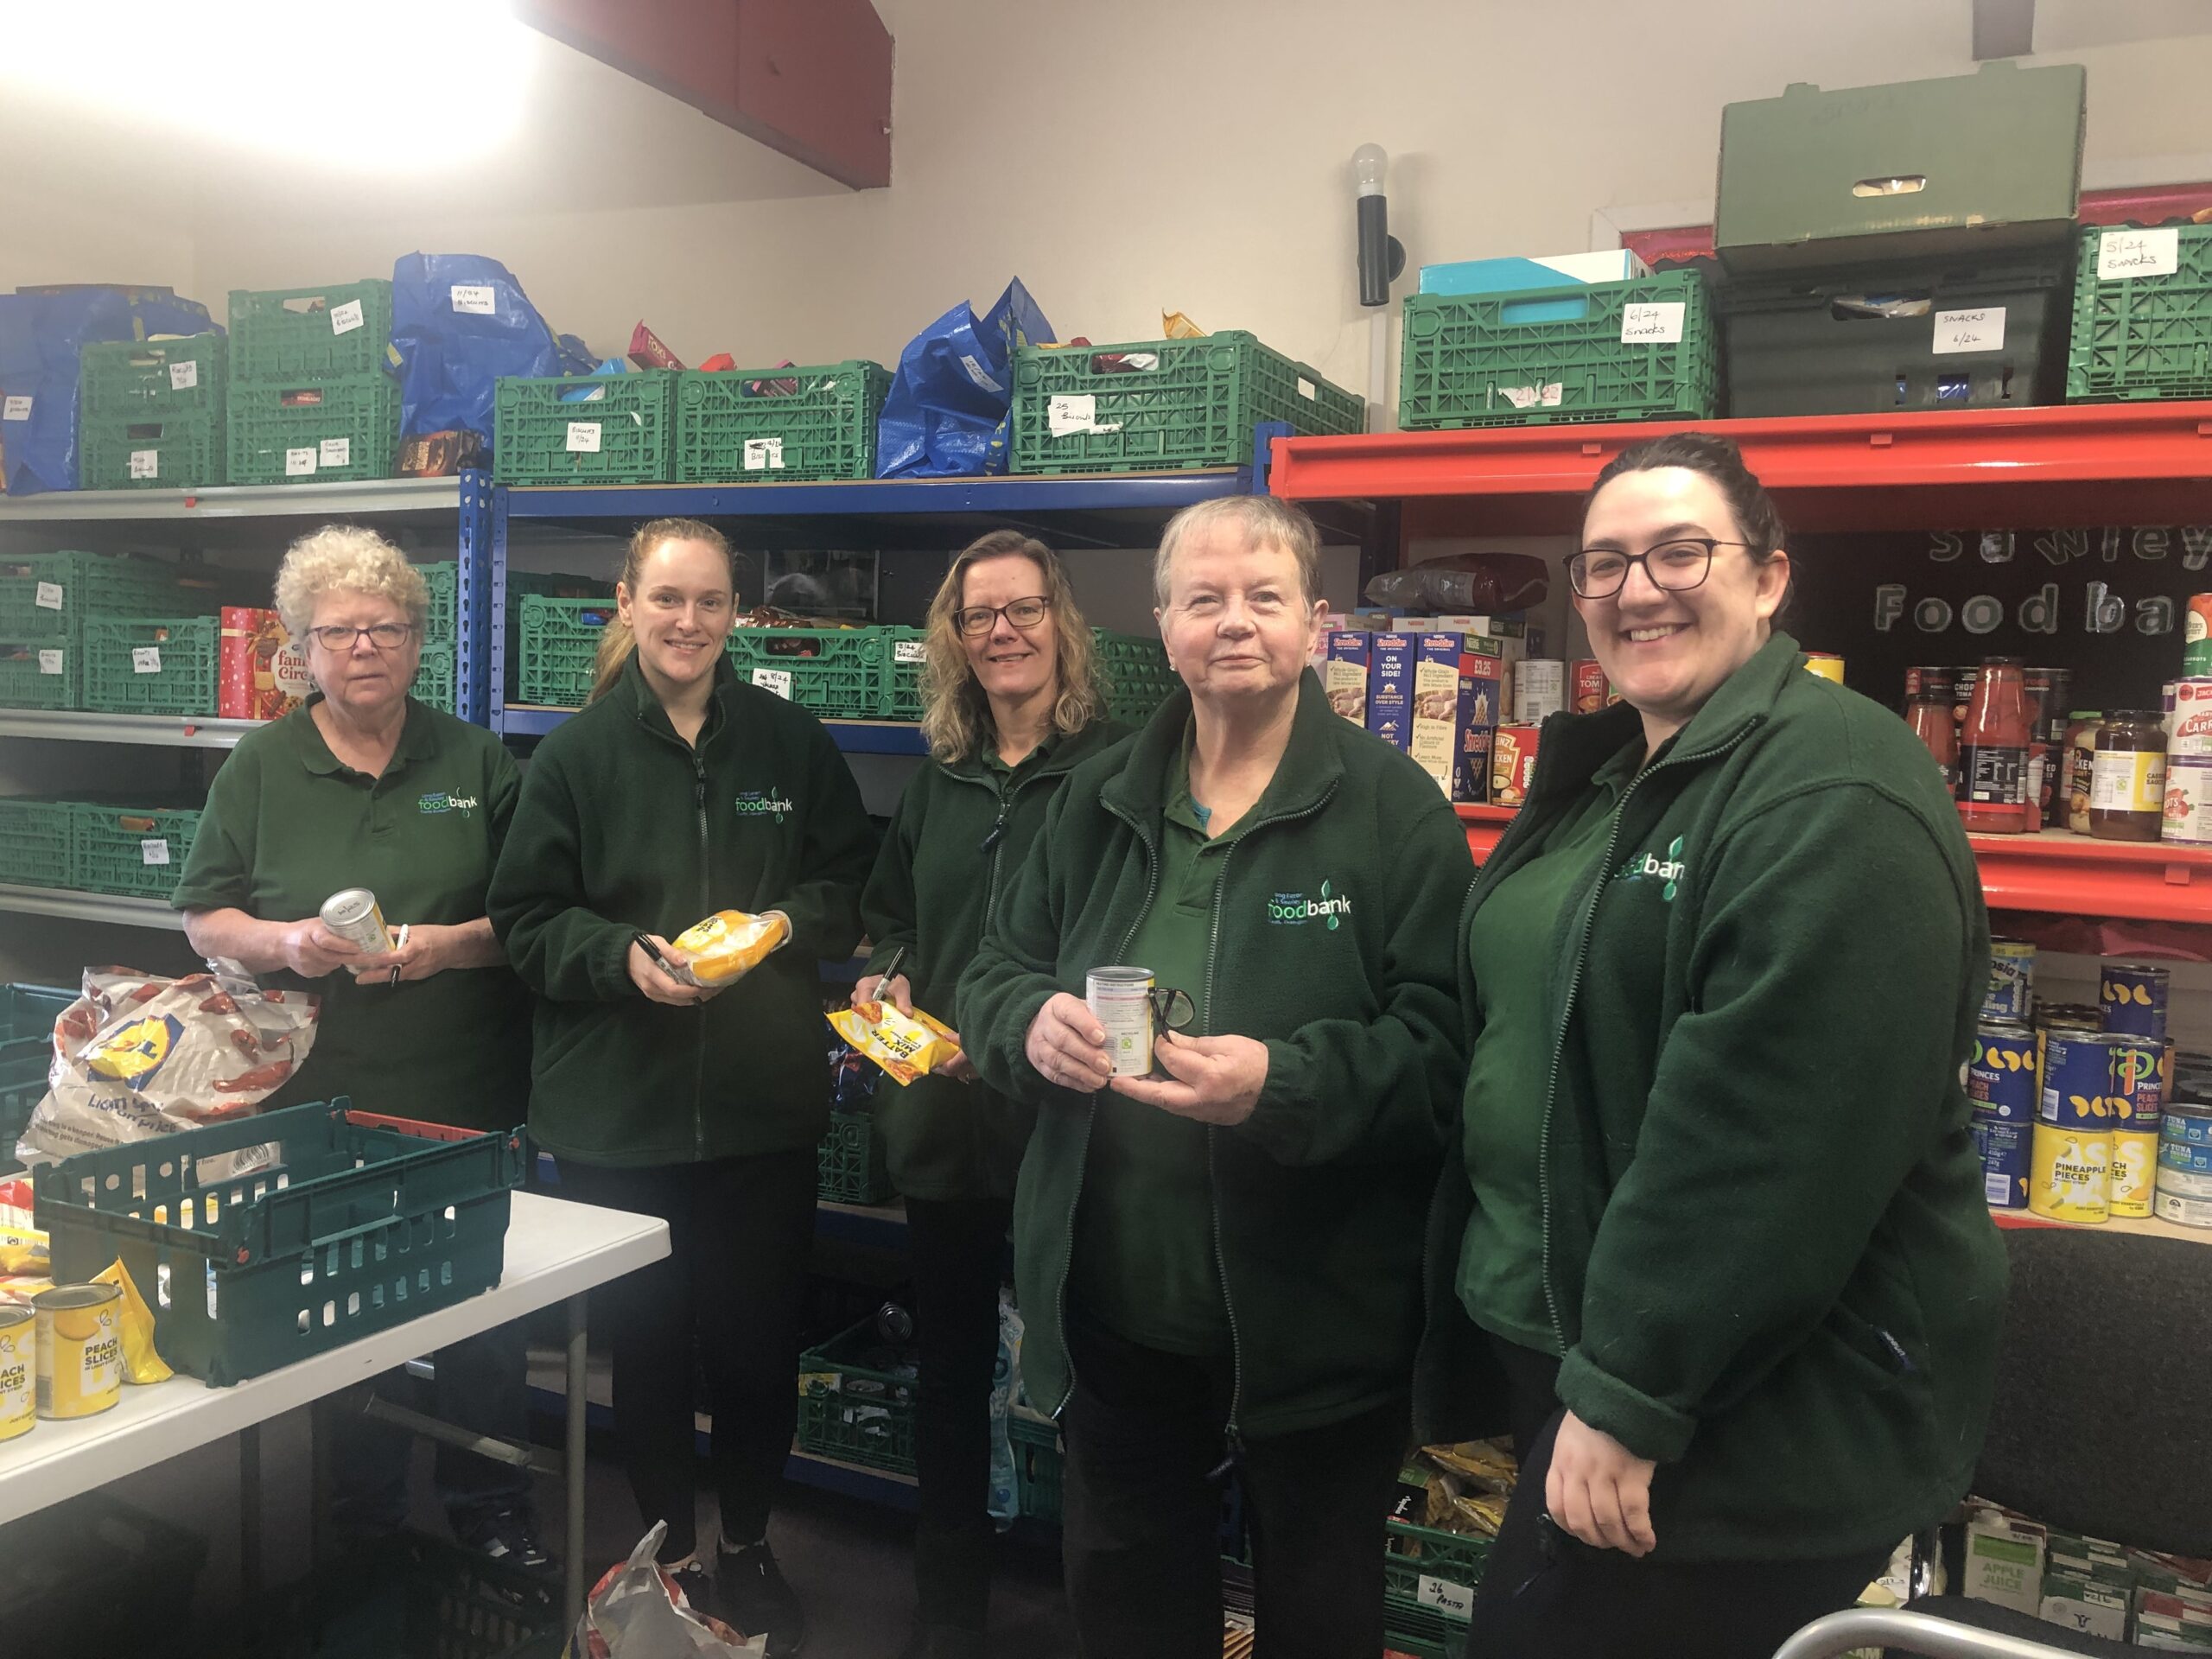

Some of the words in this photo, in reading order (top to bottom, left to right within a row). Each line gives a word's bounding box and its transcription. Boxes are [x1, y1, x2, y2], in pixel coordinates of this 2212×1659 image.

[2106, 237, 2147, 254] 5/24
[1630, 307, 1660, 323] 6/24
[1943, 313, 1986, 324] SNACKS
[1953, 332, 1981, 346] 6/24
[1874, 582, 2060, 634] Food
[2084, 580, 2177, 635] ba
[898, 643, 916, 652] 8/24
[1333, 638, 1363, 648] Shreddies
[1376, 639, 1408, 648] Shreddies
[1423, 639, 1455, 649] Shreddies
[1381, 663, 1402, 671] YOUR
[1474, 658, 1492, 677] £3.25
[2185, 719, 2212, 733] CARR
[418, 795, 478, 810] foodbank
[735, 797, 793, 812] foodbank
[872, 1029, 909, 1058] BATTER
[893, 1039, 916, 1052] MIX
[2167, 1116, 2186, 1125] TUNA
[2171, 1144, 2192, 1154] TUNA
[2056, 1162, 2107, 1174] PINEAPPLE
[2055, 1170, 2090, 1182] PIECES
[85, 1337, 118, 1356] PEACH
[85, 1346, 118, 1366] SLICES
[0, 1363, 26, 1379] ACH
[0, 1375, 26, 1389] ICES
[1982, 1562, 2026, 1578] APPLE
[1983, 1573, 2023, 1591] JUICE
